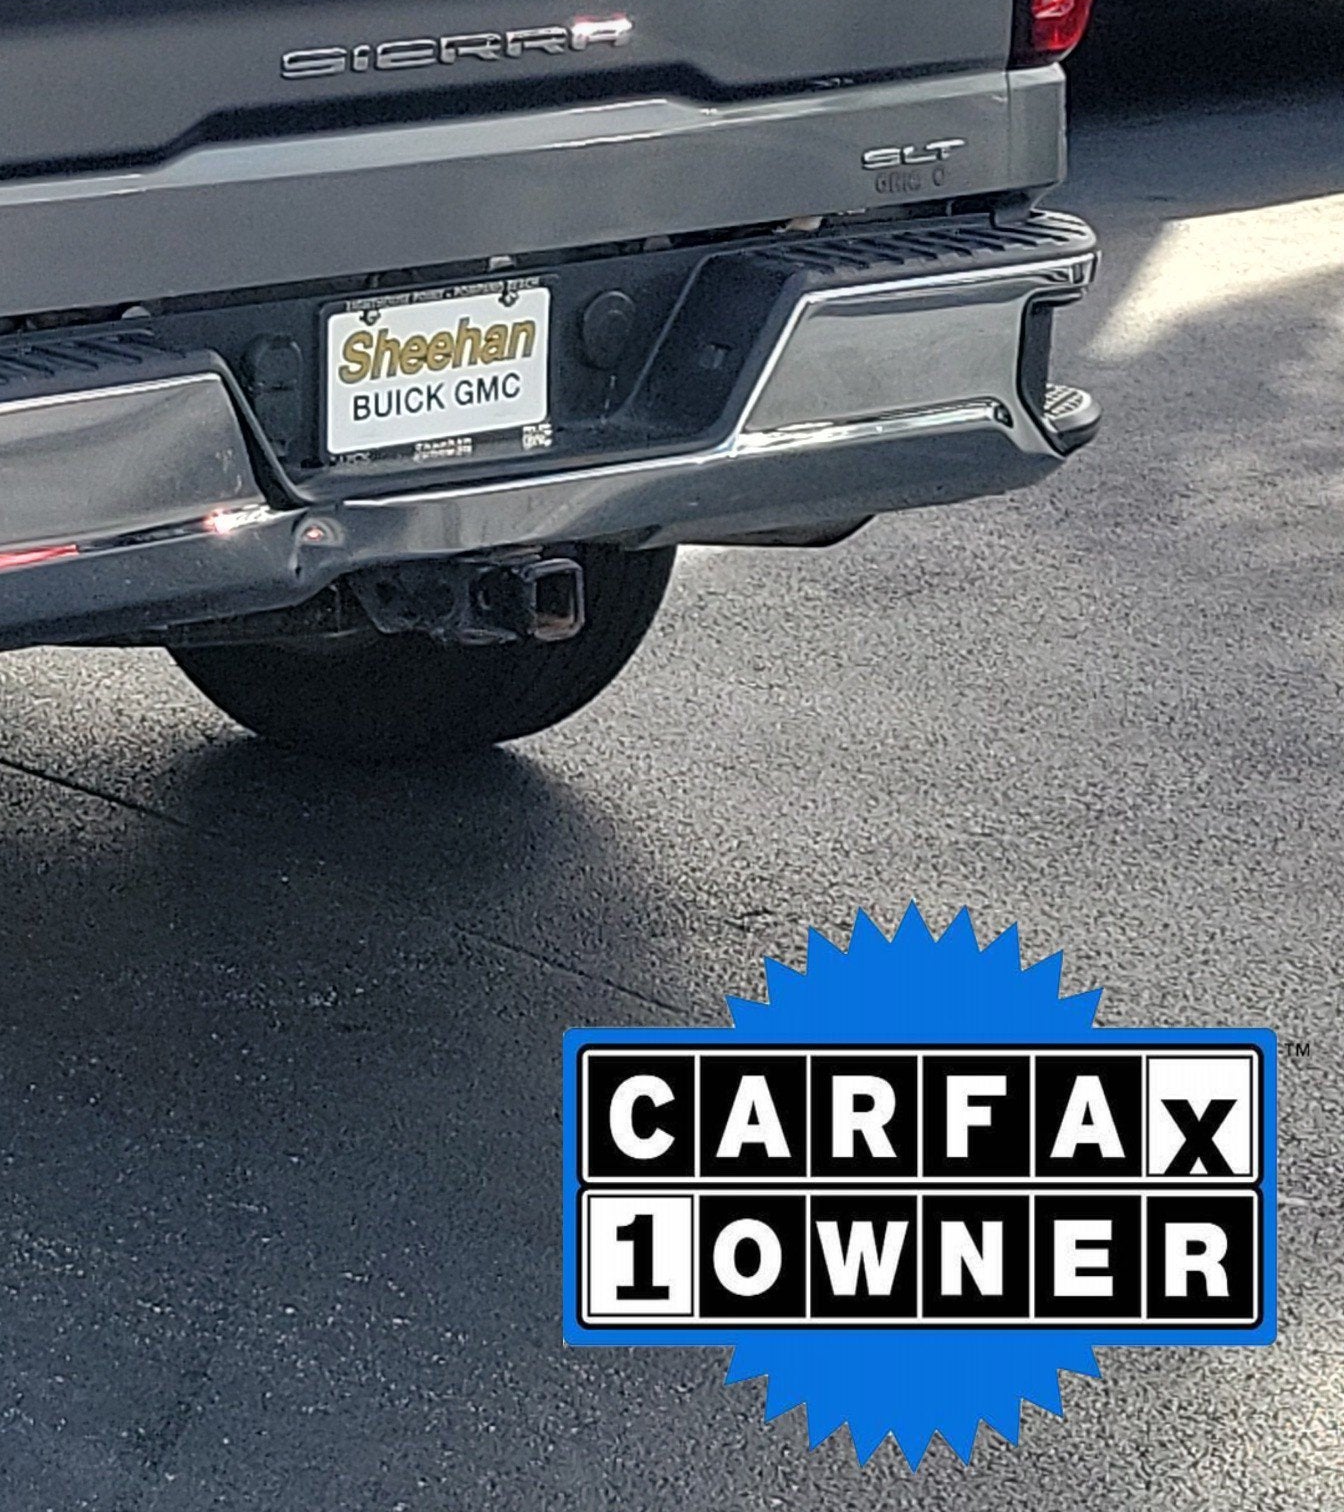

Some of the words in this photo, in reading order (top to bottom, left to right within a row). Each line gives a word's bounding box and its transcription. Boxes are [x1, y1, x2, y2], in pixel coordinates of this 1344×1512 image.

[281, 13, 635, 79] SIERRA
[861, 138, 966, 169] SLT
[338, 317, 536, 385] Sheehan
[352, 382, 445, 421] BUICK
[454, 372, 521, 406] GMC
